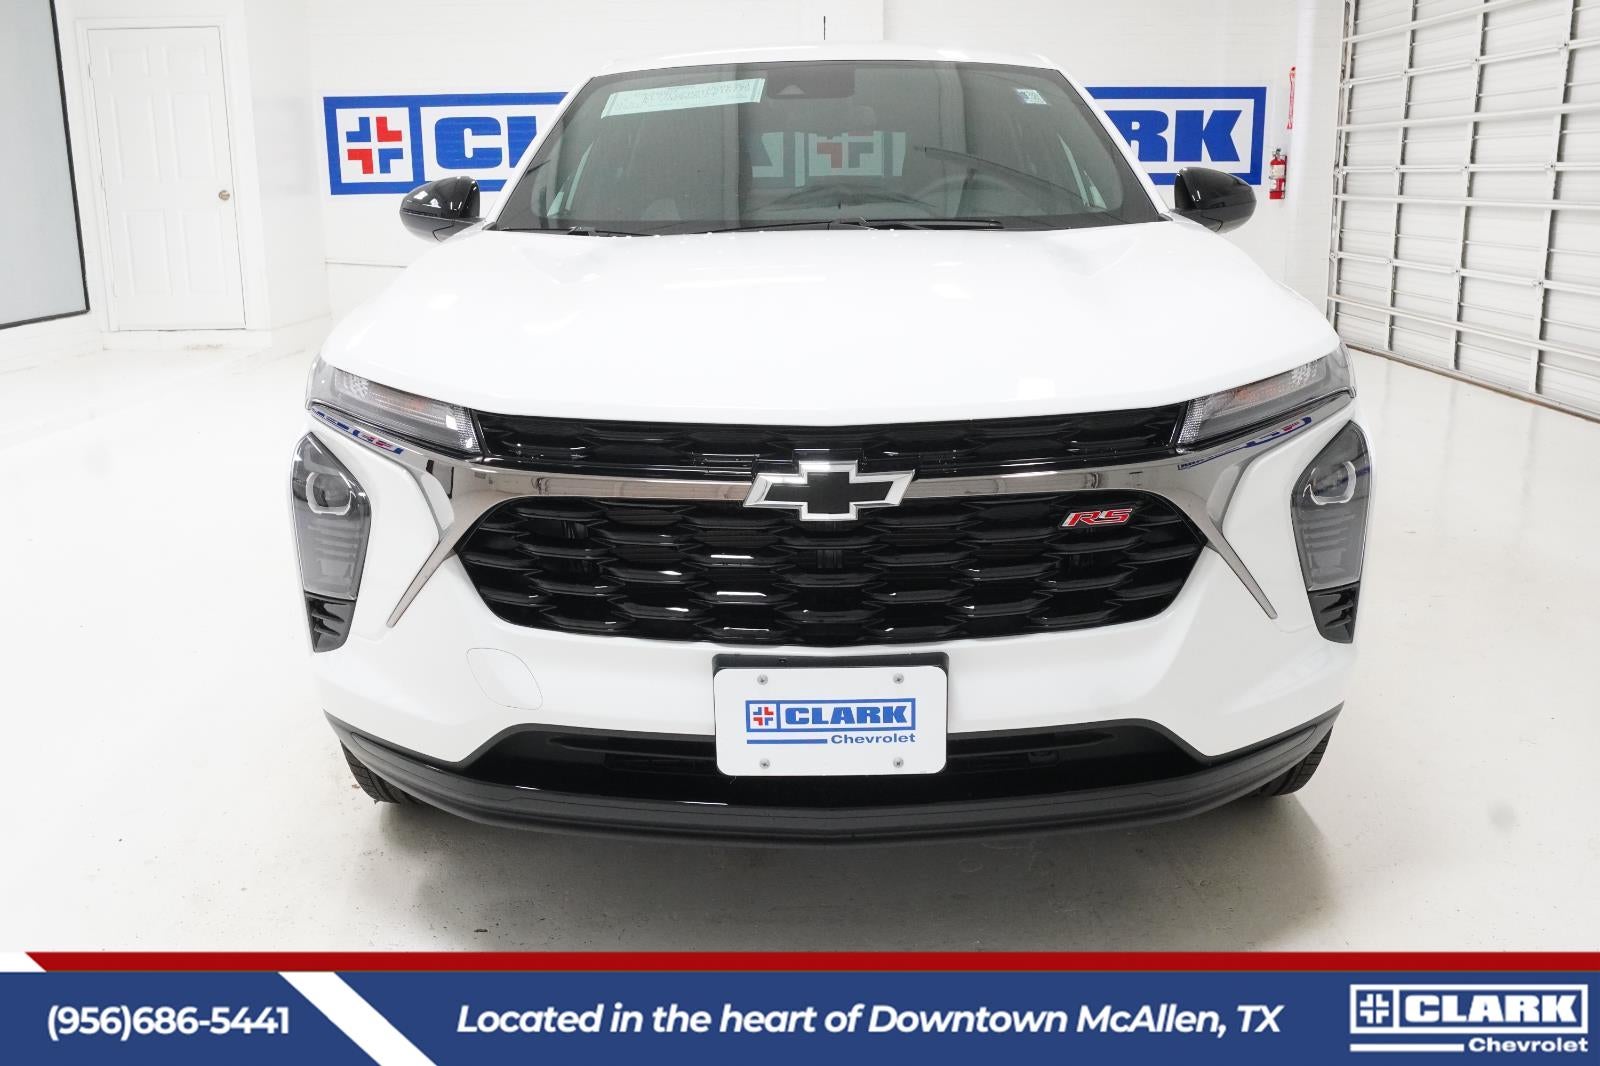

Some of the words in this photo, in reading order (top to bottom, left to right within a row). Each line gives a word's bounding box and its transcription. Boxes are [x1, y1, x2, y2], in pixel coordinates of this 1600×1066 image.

[1061, 508, 1133, 527] RS
[785, 706, 908, 725] CLARK
[831, 733, 916, 744] Chevrolet
